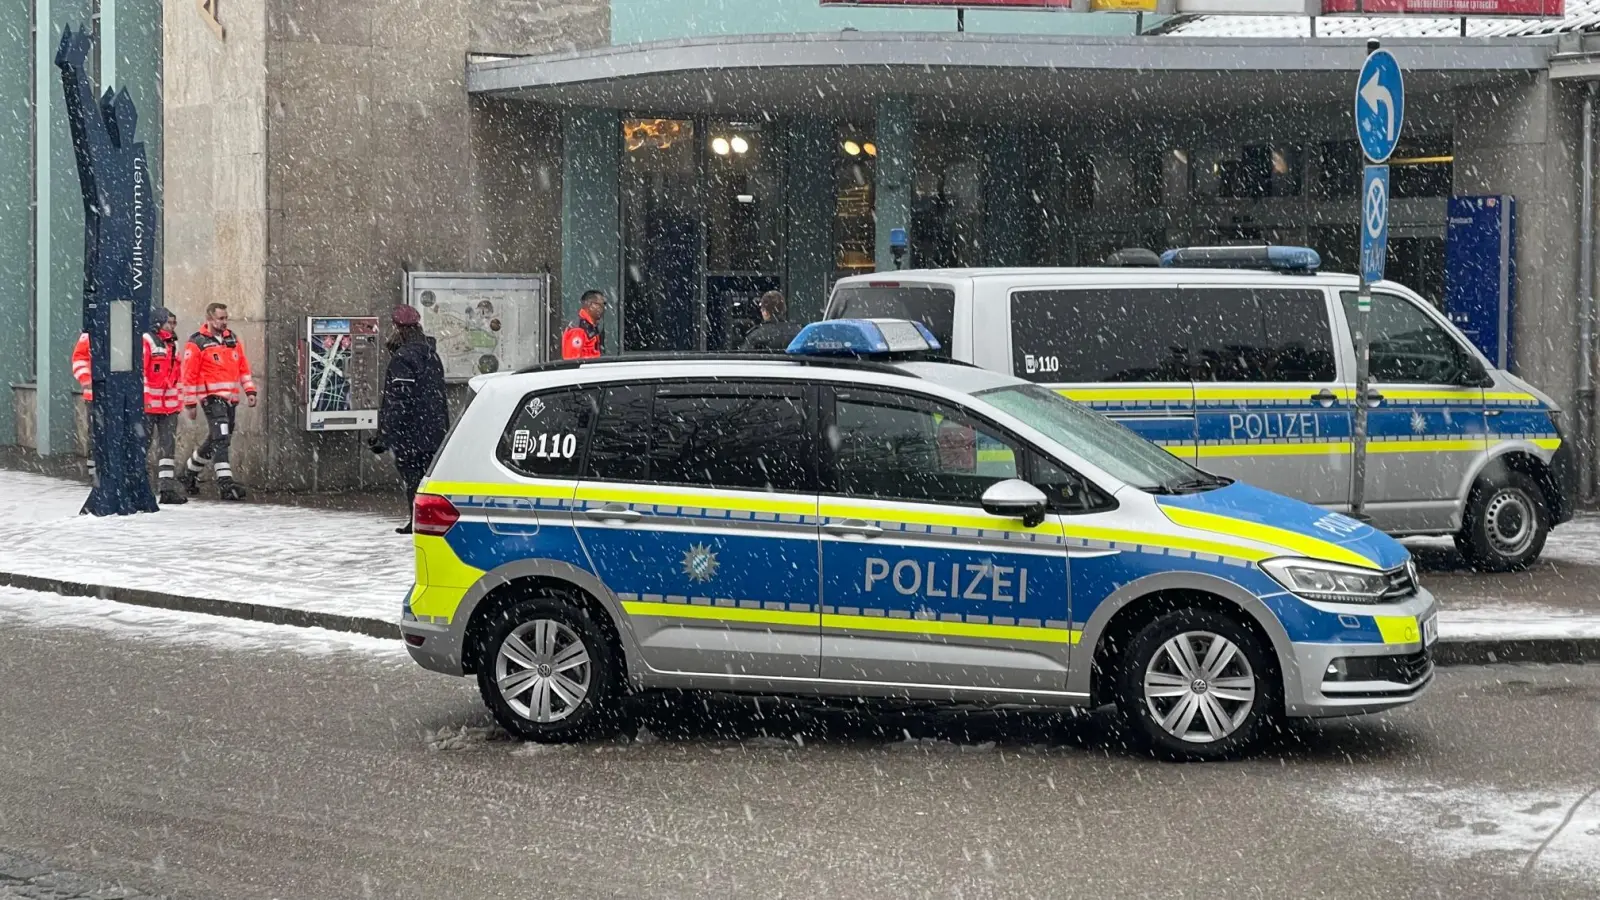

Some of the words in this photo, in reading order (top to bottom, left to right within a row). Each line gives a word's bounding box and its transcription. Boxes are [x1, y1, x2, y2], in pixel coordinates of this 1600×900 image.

[133, 157, 144, 290] Willkommen
[1365, 247, 1384, 273] TAXI
[1039, 356, 1059, 372] 110
[1229, 412, 1320, 439] POLIZEI
[536, 433, 576, 458] 110
[864, 557, 1028, 603] POLIZEI
